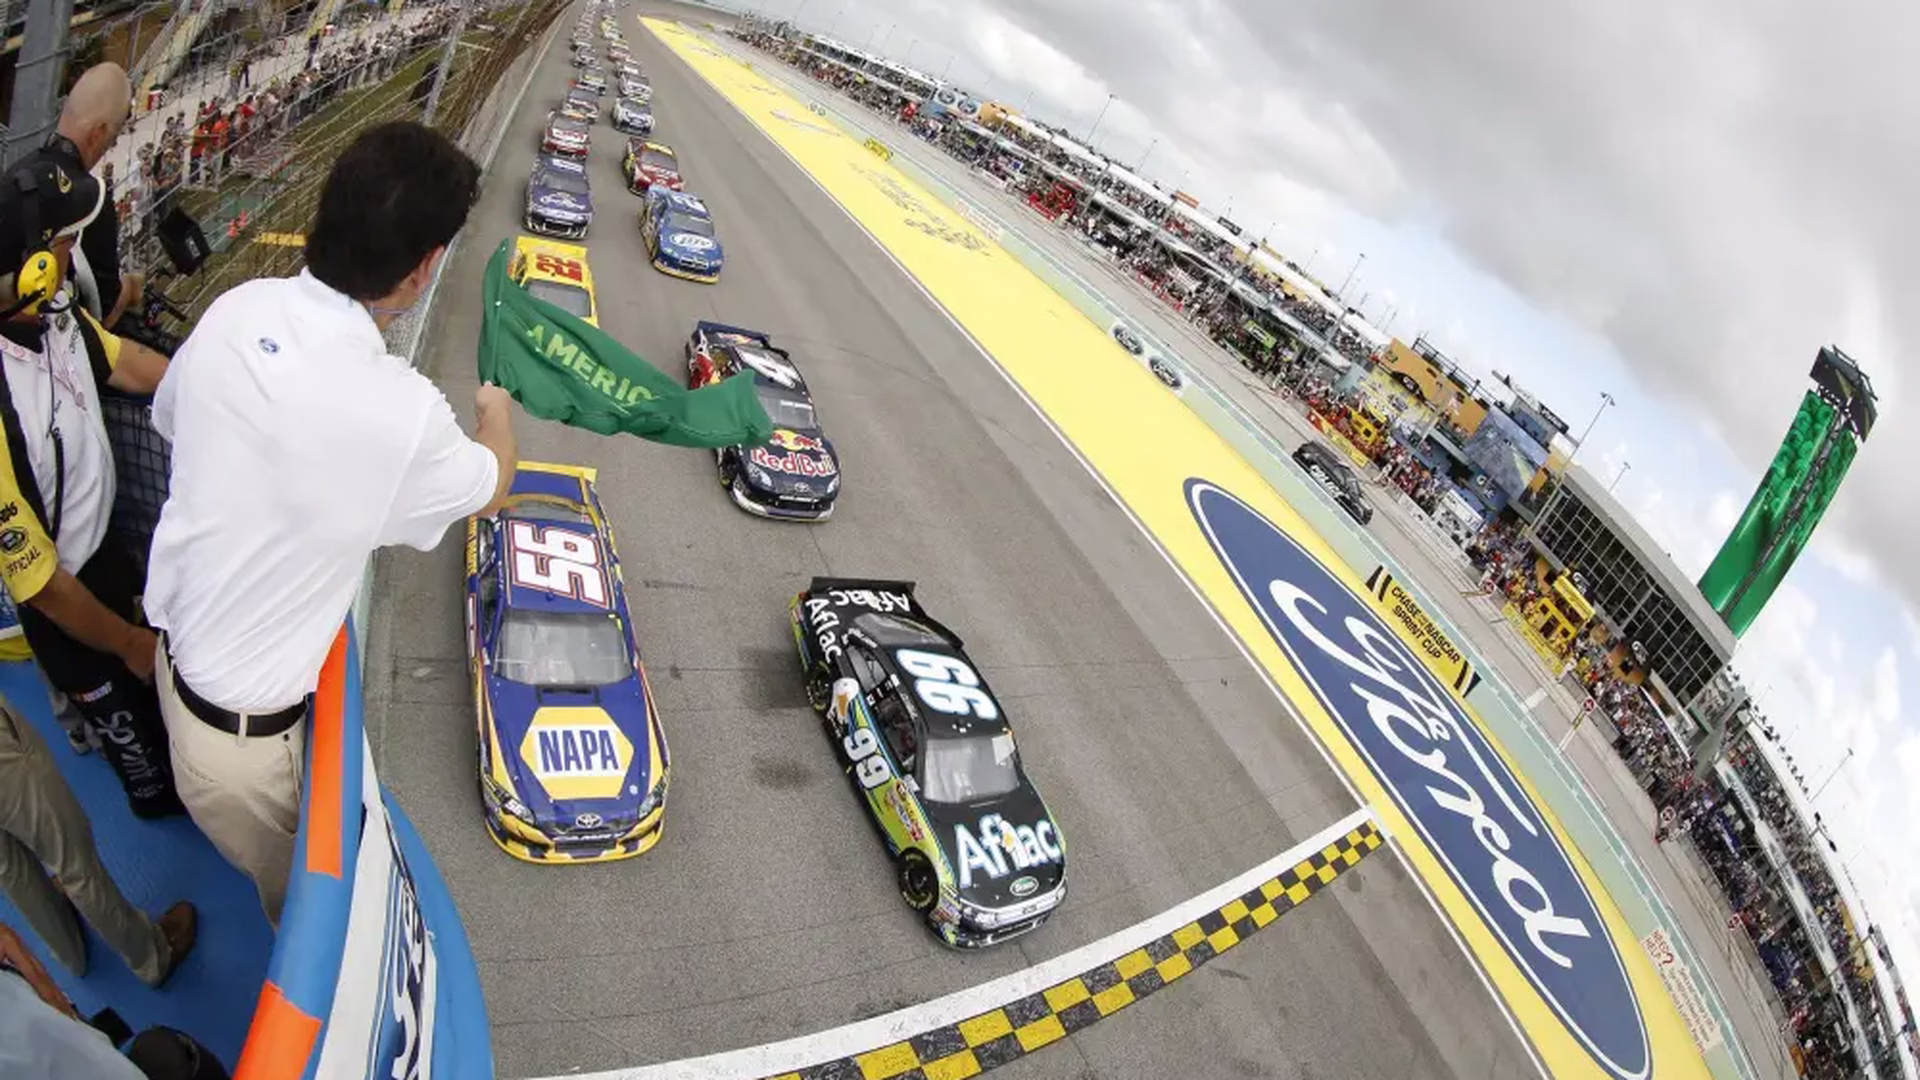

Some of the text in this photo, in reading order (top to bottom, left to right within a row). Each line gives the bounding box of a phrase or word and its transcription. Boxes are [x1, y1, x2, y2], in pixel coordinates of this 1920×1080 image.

[536, 252, 583, 282] 22
[526, 323, 653, 409] AMERIC
[750, 446, 838, 478] Red Bull
[507, 519, 609, 609] 56
[805, 598, 843, 663] Aflac
[829, 589, 911, 612] Aflac
[1391, 586, 1461, 664] CHASE NASCAR
[1391, 605, 1443, 660] SPRINT CUP
[896, 648, 999, 722] 99
[538, 729, 620, 773] NAPA
[843, 727, 891, 789] 99
[1268, 578, 1592, 970] Ford
[506, 799, 531, 818] 56
[953, 812, 1063, 889] Aflac
